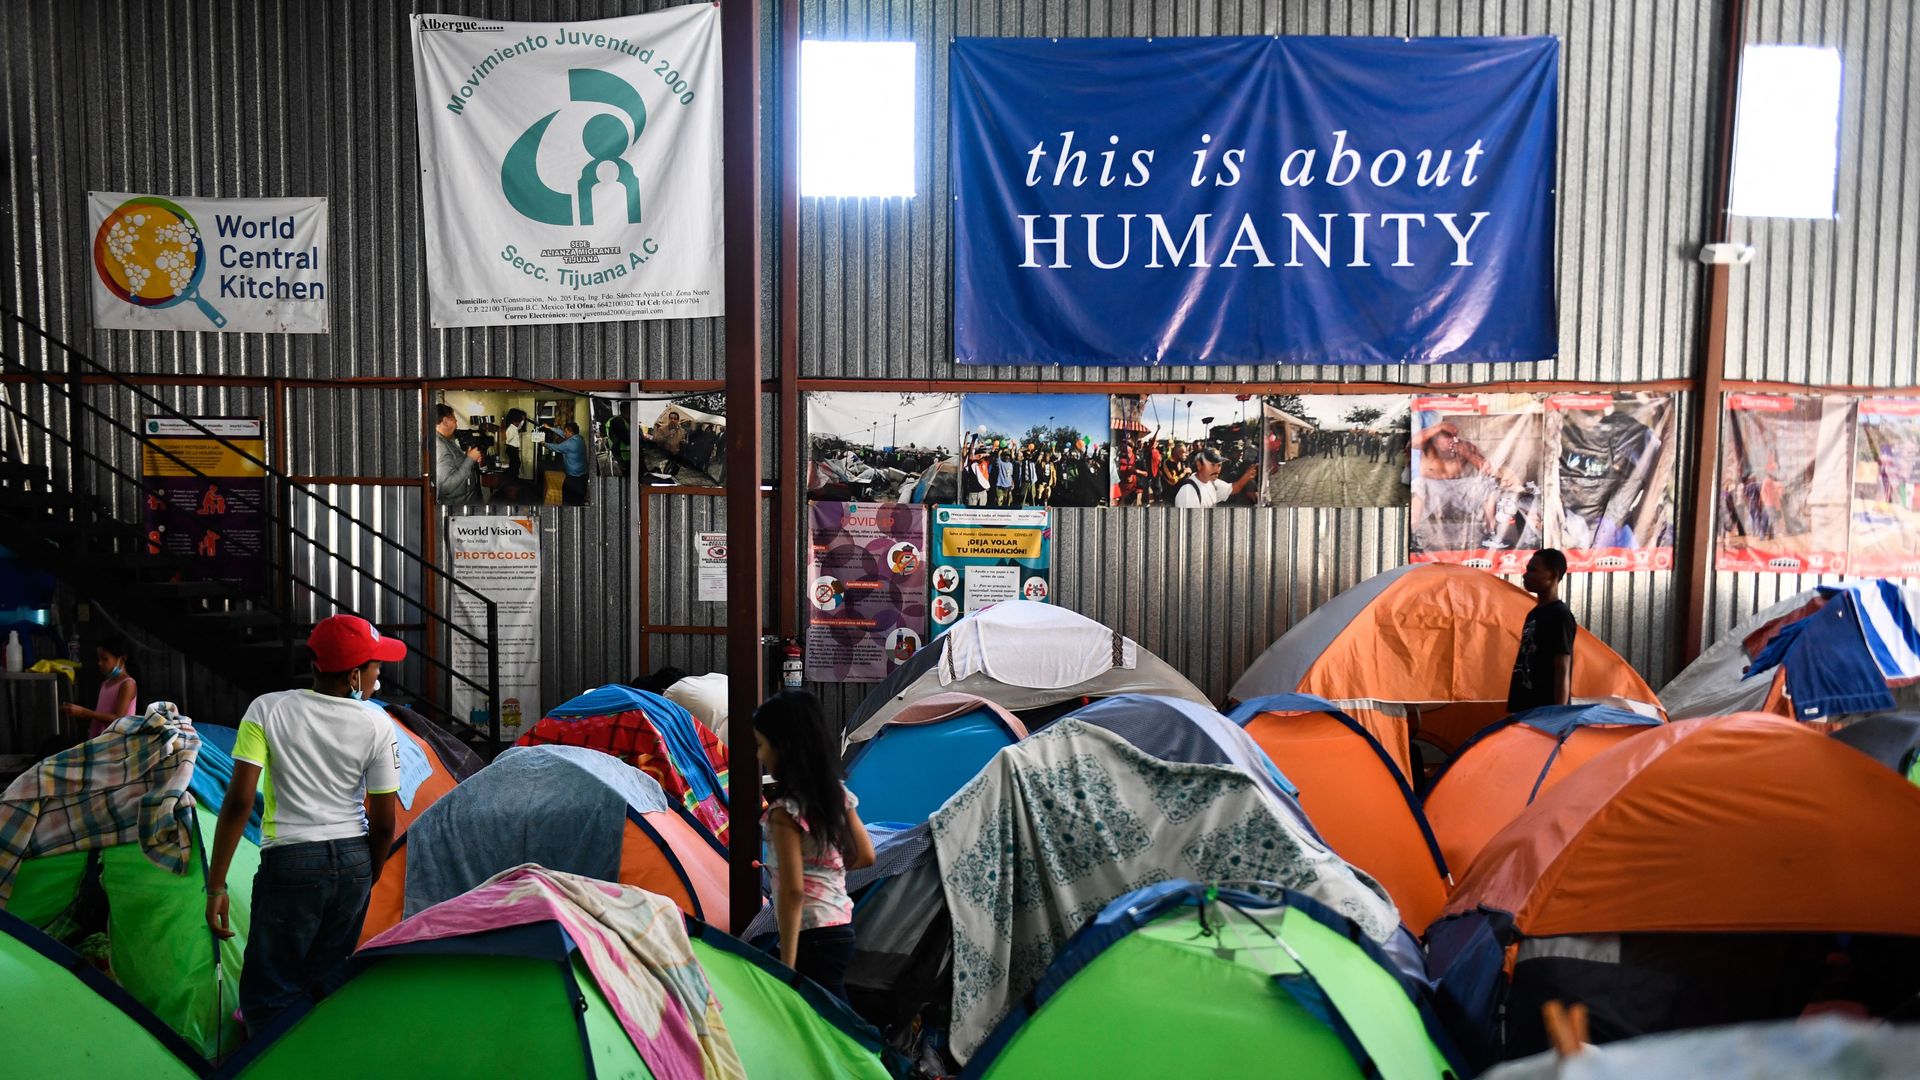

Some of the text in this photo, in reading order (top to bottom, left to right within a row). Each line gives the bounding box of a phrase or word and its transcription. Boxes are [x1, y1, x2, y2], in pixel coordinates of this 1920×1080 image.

[446, 28, 695, 116] Movimiento Juventud 2000
[1024, 129, 1486, 188] this is about
[215, 214, 295, 239] World
[541, 247, 620, 257] ALIANZA MIGRANTE
[1017, 211, 1490, 270] HUMANITY
[219, 244, 318, 270] Central
[500, 245, 549, 282] Secc.
[557, 263, 627, 290] Tijuana
[563, 256, 599, 264] TIJUANA
[220, 274, 325, 299] Kitchen
[642, 291, 660, 299] Ayala
[457, 526, 522, 536] World Vision
[456, 552, 536, 560] PROTOCOLOS
[970, 546, 1027, 555] IMAGINACIÓN!
